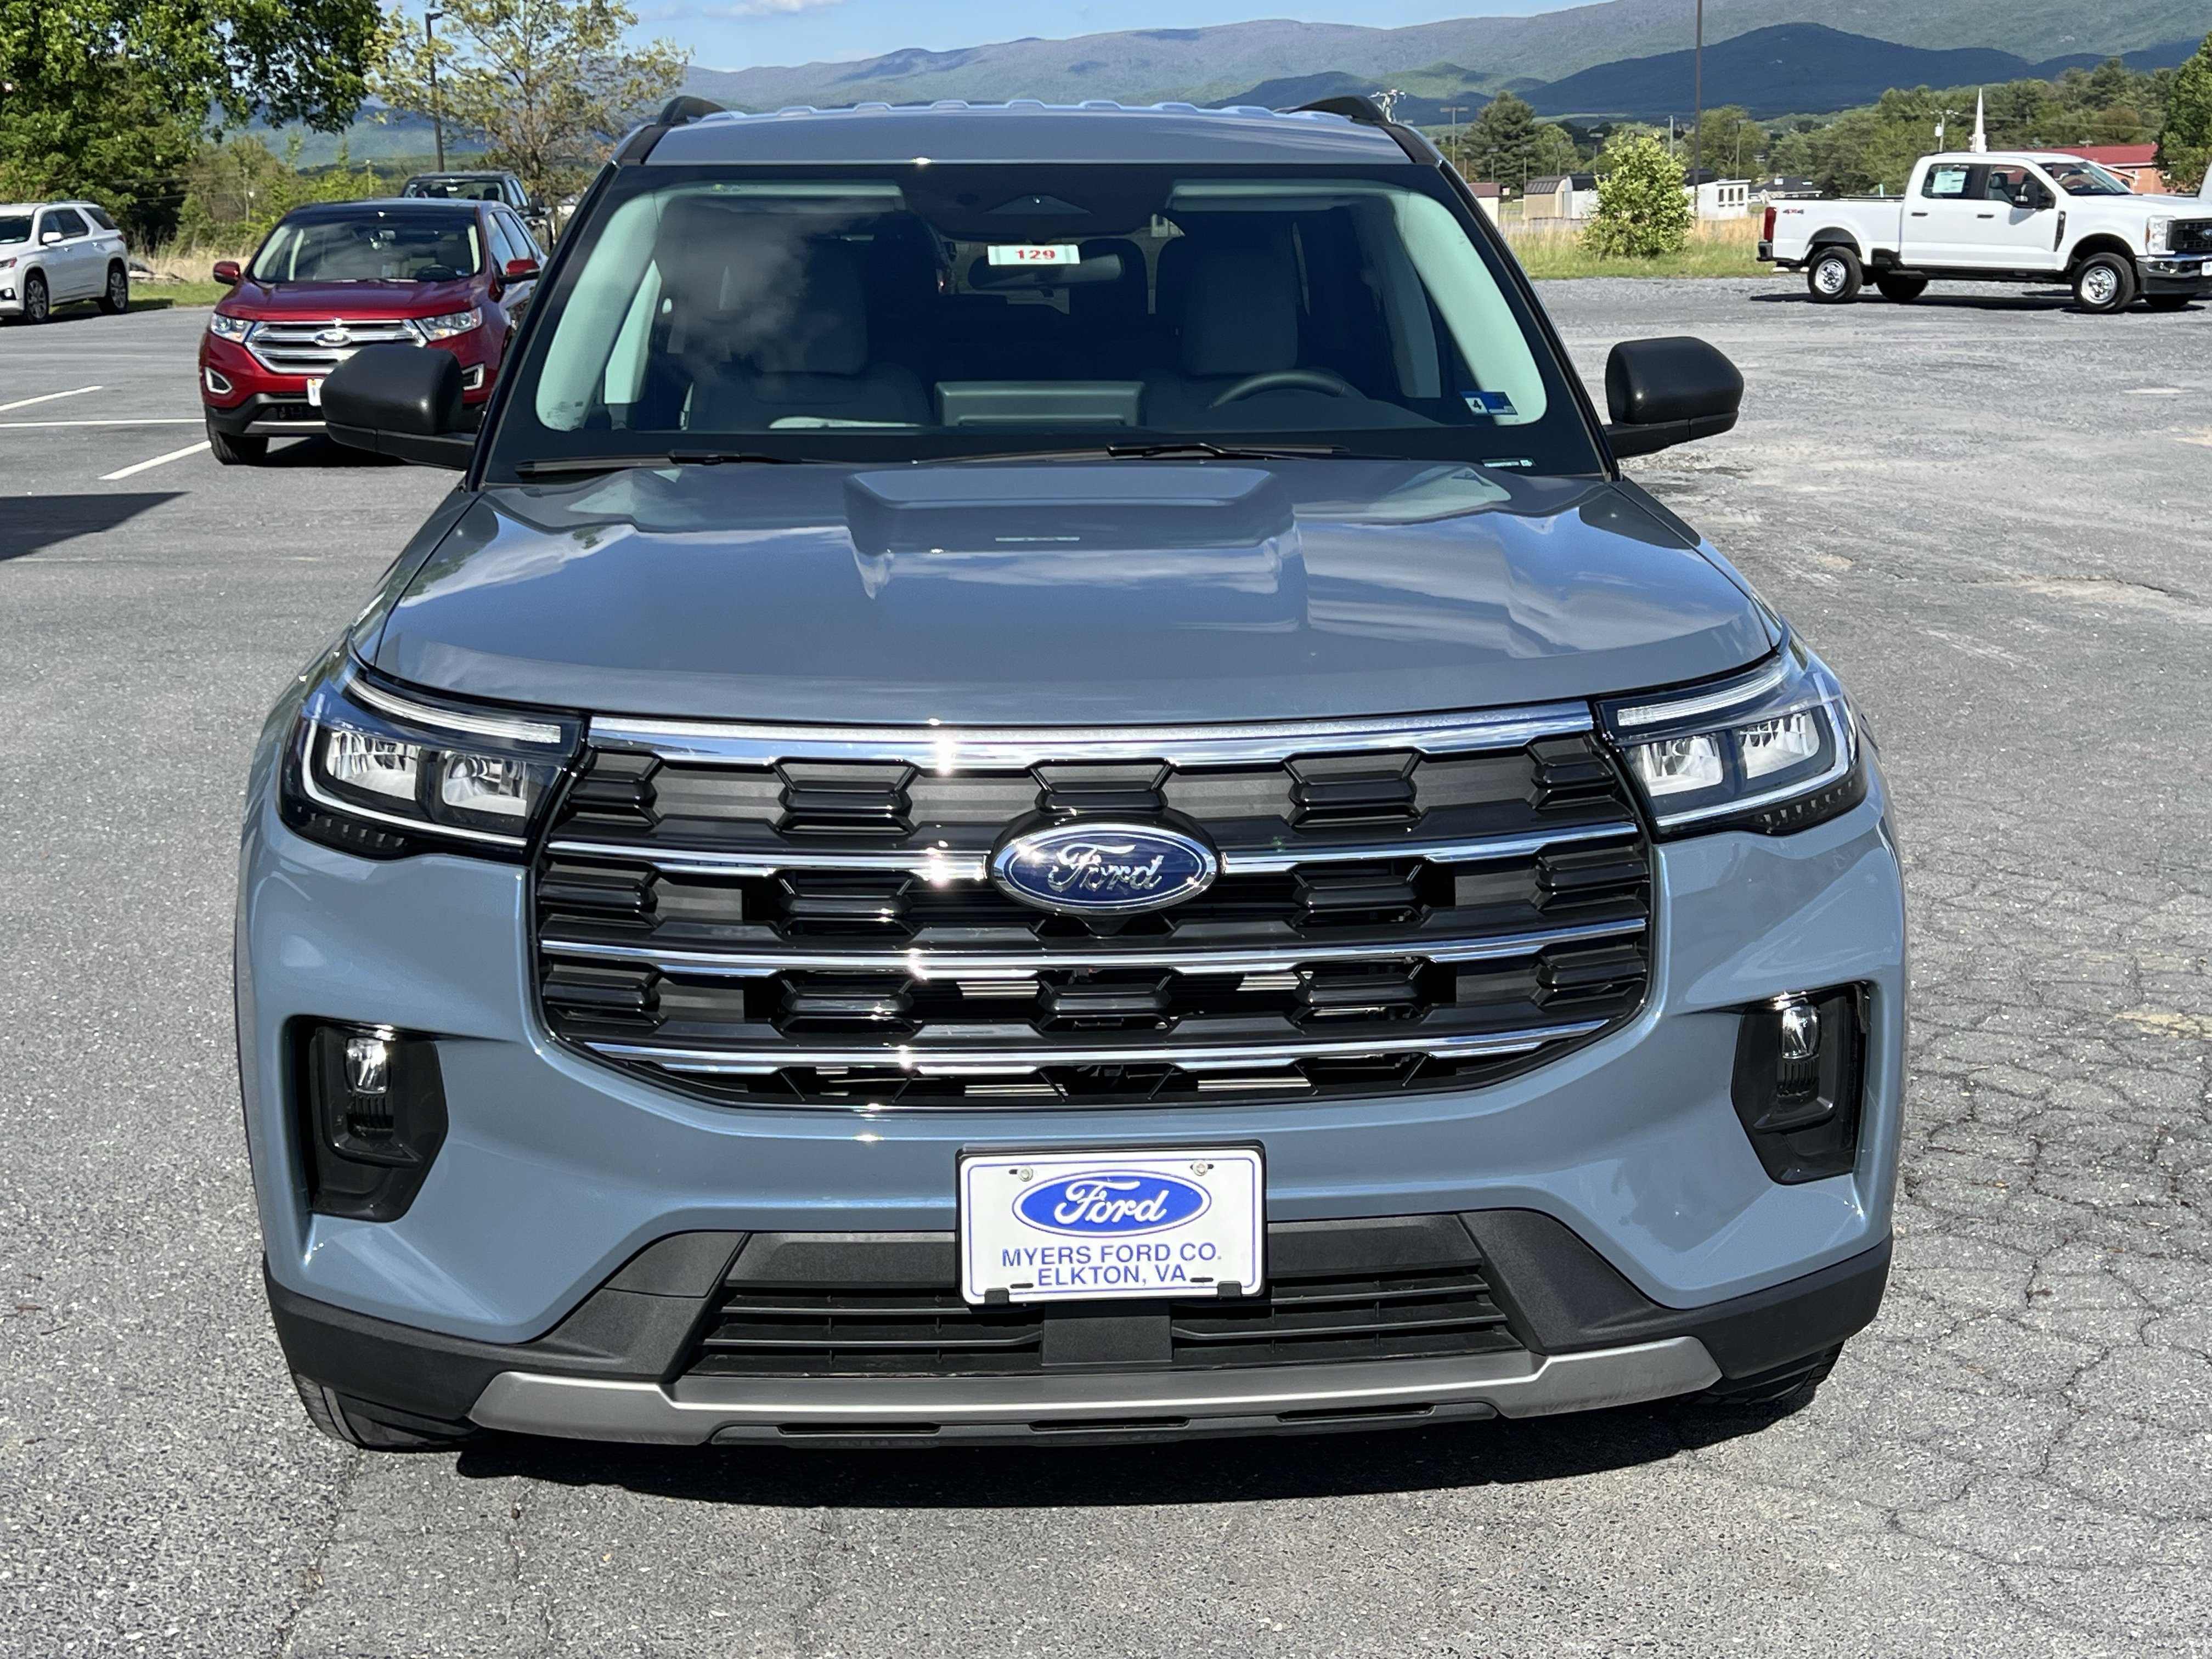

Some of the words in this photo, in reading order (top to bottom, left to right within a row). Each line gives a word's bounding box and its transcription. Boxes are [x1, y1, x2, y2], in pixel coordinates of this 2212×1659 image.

[1016, 250, 1056, 259] 129
[1472, 399, 1481, 409] 4
[1047, 843, 1164, 893] Ford
[1054, 1180, 1169, 1224] Ford
[1001, 1245, 1091, 1267] MYERS
[1101, 1244, 1170, 1262] FORD
[1180, 1242, 1222, 1261] CO.
[1038, 1265, 1147, 1286] ELKTON,
[1155, 1263, 1187, 1282] VA
